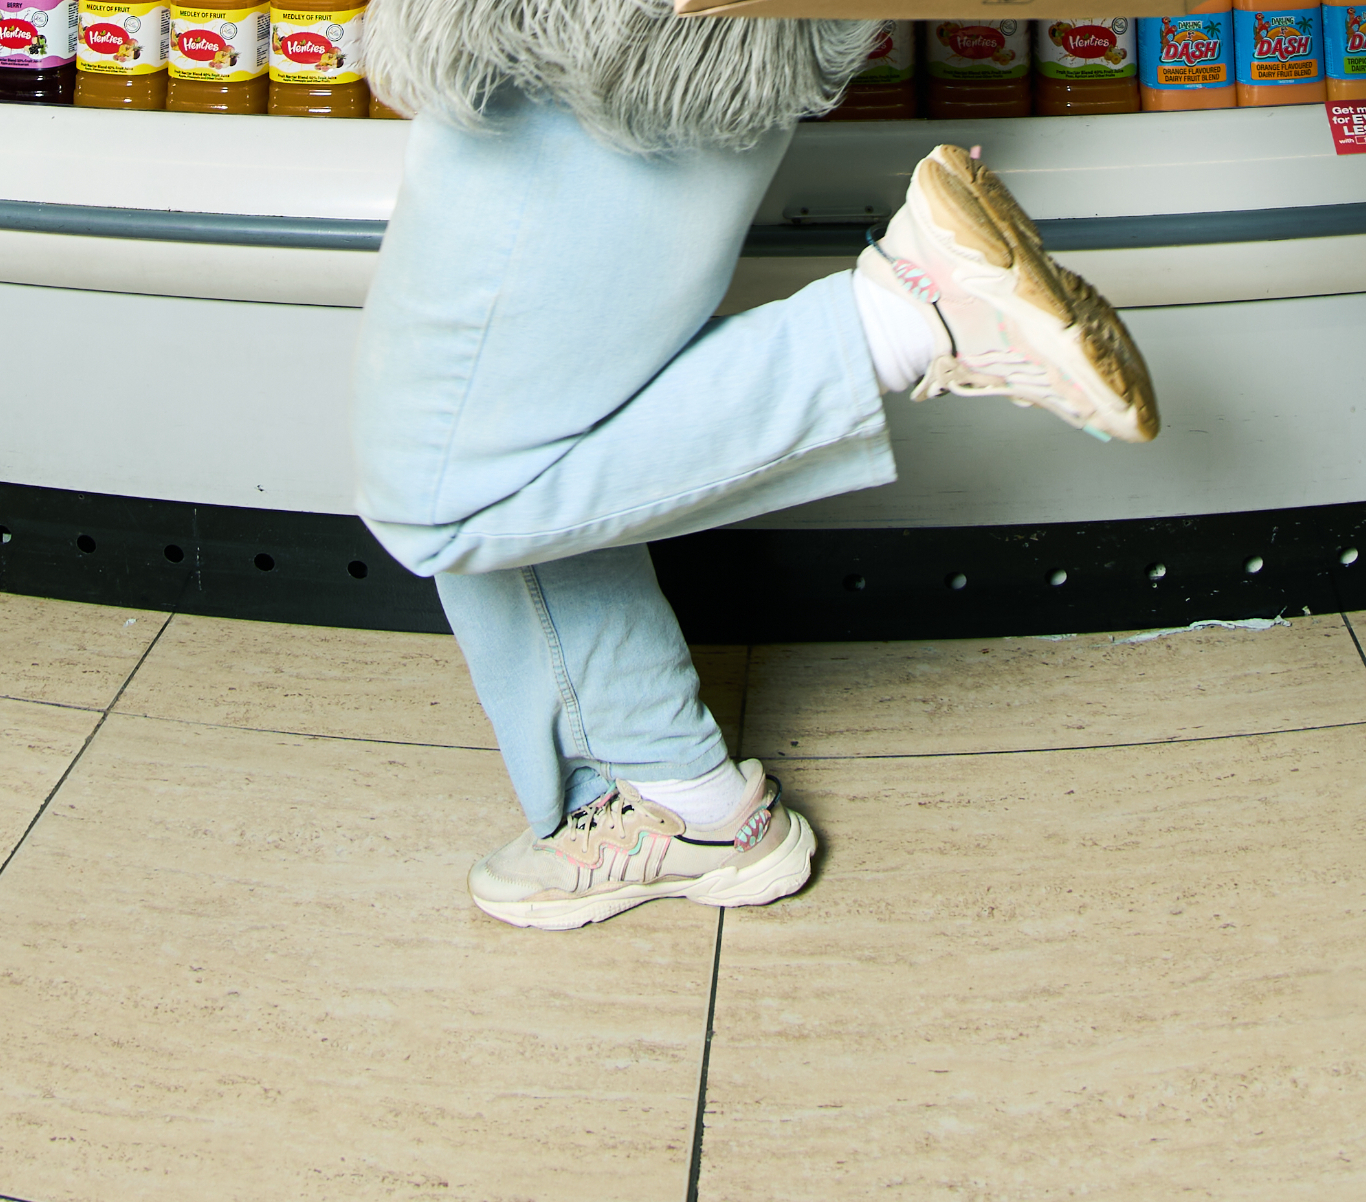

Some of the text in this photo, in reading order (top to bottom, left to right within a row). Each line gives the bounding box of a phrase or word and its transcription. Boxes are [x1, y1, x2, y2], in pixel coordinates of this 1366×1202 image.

[180, 10, 201, 19] MEDLEY
[210, 12, 226, 20] FRUIT
[282, 13, 305, 21] MEDLEY
[89, 31, 124, 45] Henties
[956, 36, 997, 48] Henties
[1069, 35, 1109, 48] Henties
[183, 38, 219, 52] Henties
[287, 41, 326, 54] Henties
[1255, 36, 1311, 61] DASH
[1162, 40, 1219, 65] DASH
[1332, 106, 1354, 115] Get
[1333, 116, 1350, 125] for
